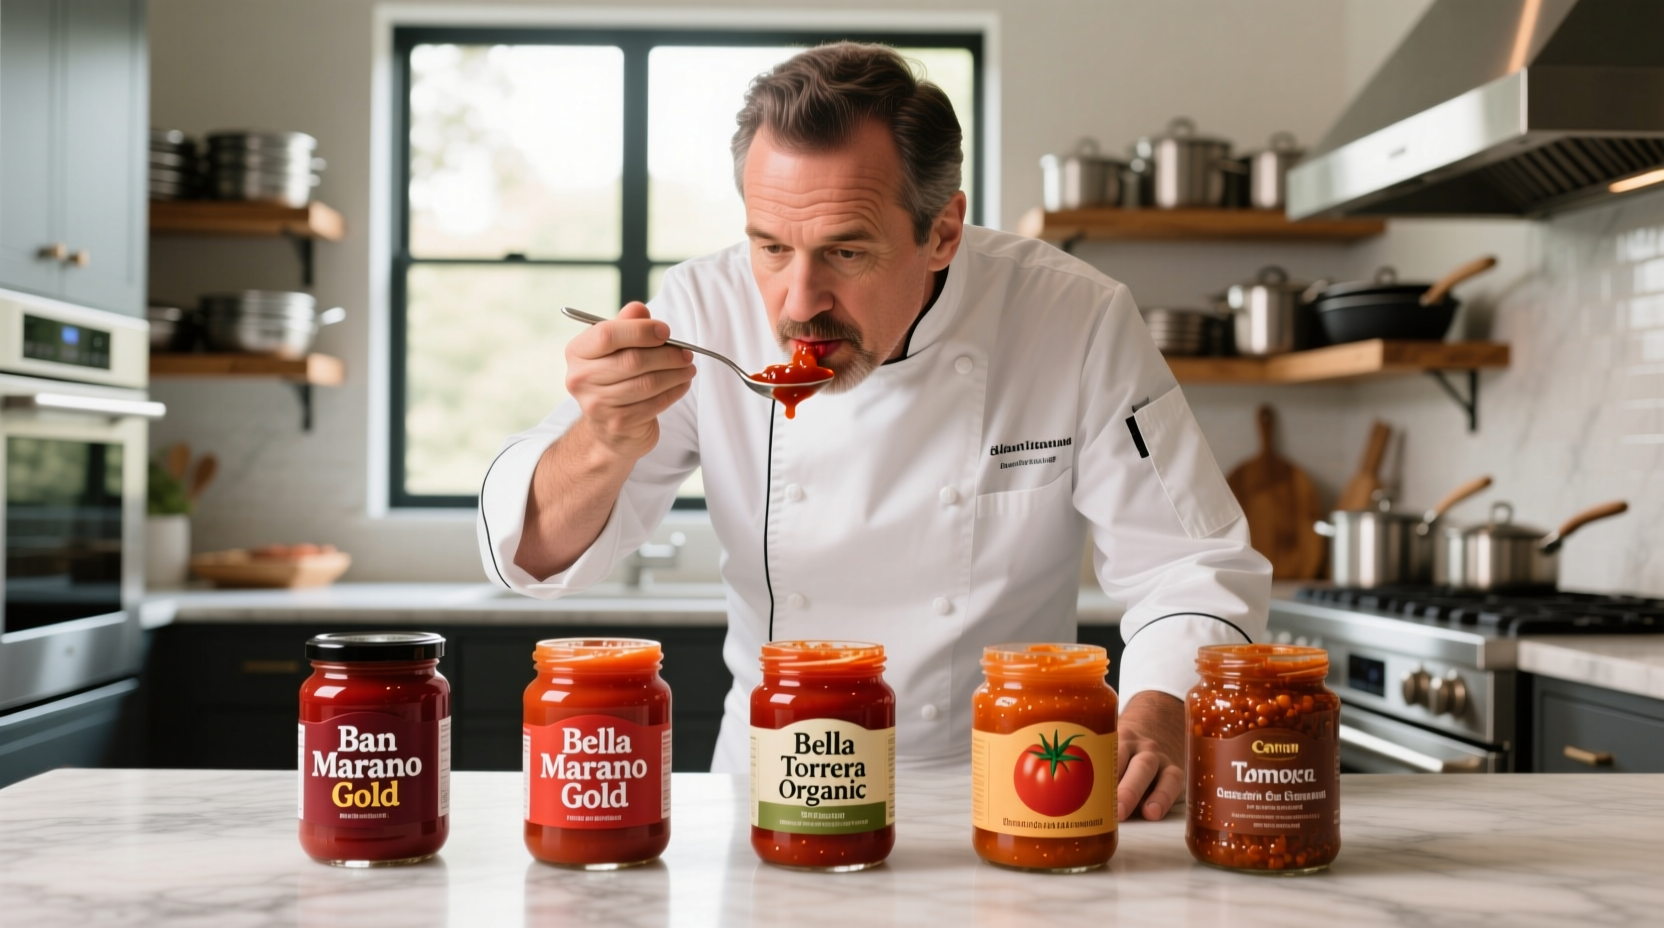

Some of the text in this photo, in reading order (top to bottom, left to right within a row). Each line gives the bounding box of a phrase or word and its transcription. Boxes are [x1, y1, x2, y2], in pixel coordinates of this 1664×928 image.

[338, 725, 397, 752] Ban
[562, 727, 632, 754] Bella
[794, 731, 855, 755] Bella
[312, 750, 422, 778] Marano
[540, 753, 647, 780] Marano
[780, 755, 866, 778] Torrera
[332, 780, 400, 808] Gold
[561, 781, 629, 809] Gold
[779, 779, 866, 807] Organic
